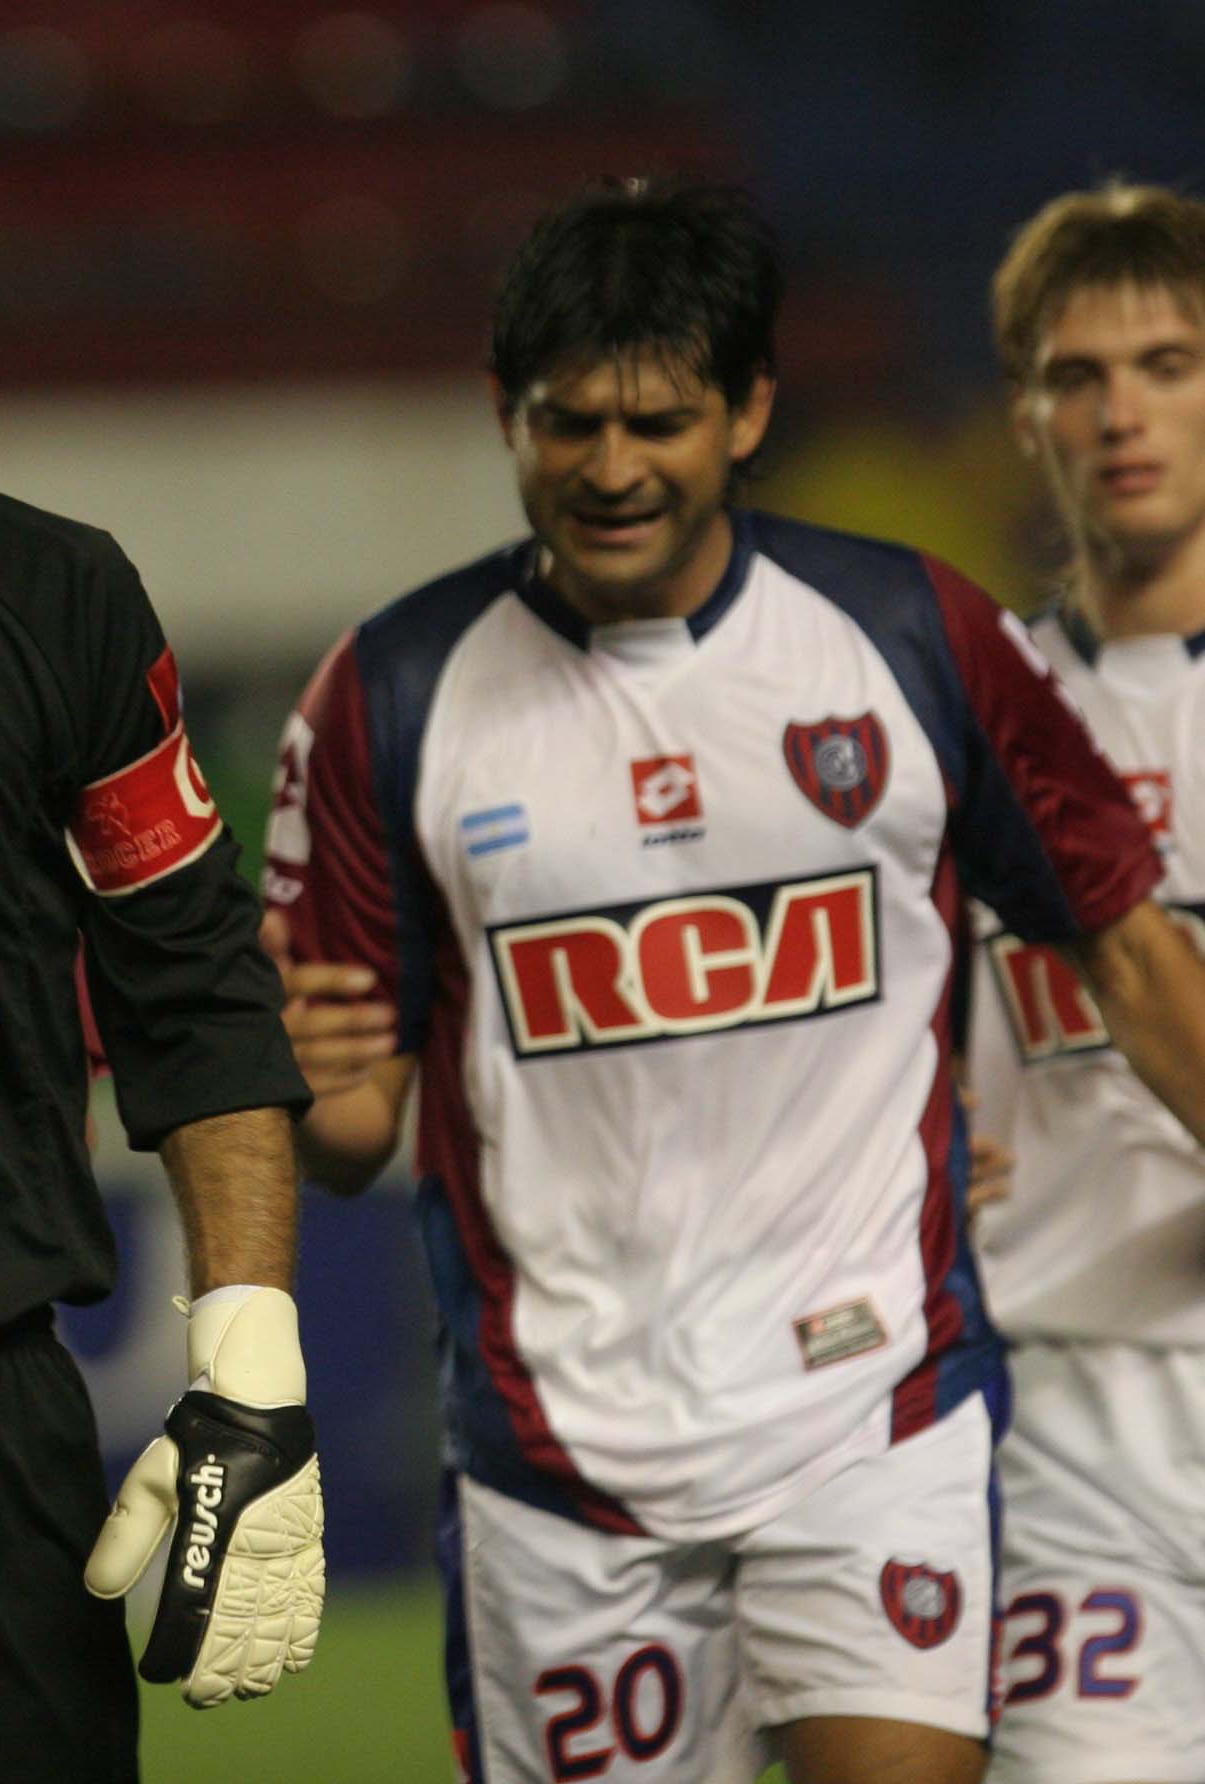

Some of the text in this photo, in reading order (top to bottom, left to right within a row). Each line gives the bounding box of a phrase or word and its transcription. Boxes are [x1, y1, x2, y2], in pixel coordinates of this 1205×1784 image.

[500, 876, 873, 1050] RCA
[183, 1462, 224, 1589] reusch
[532, 1640, 684, 1784] 20
[1004, 1585, 1145, 1707] 32
